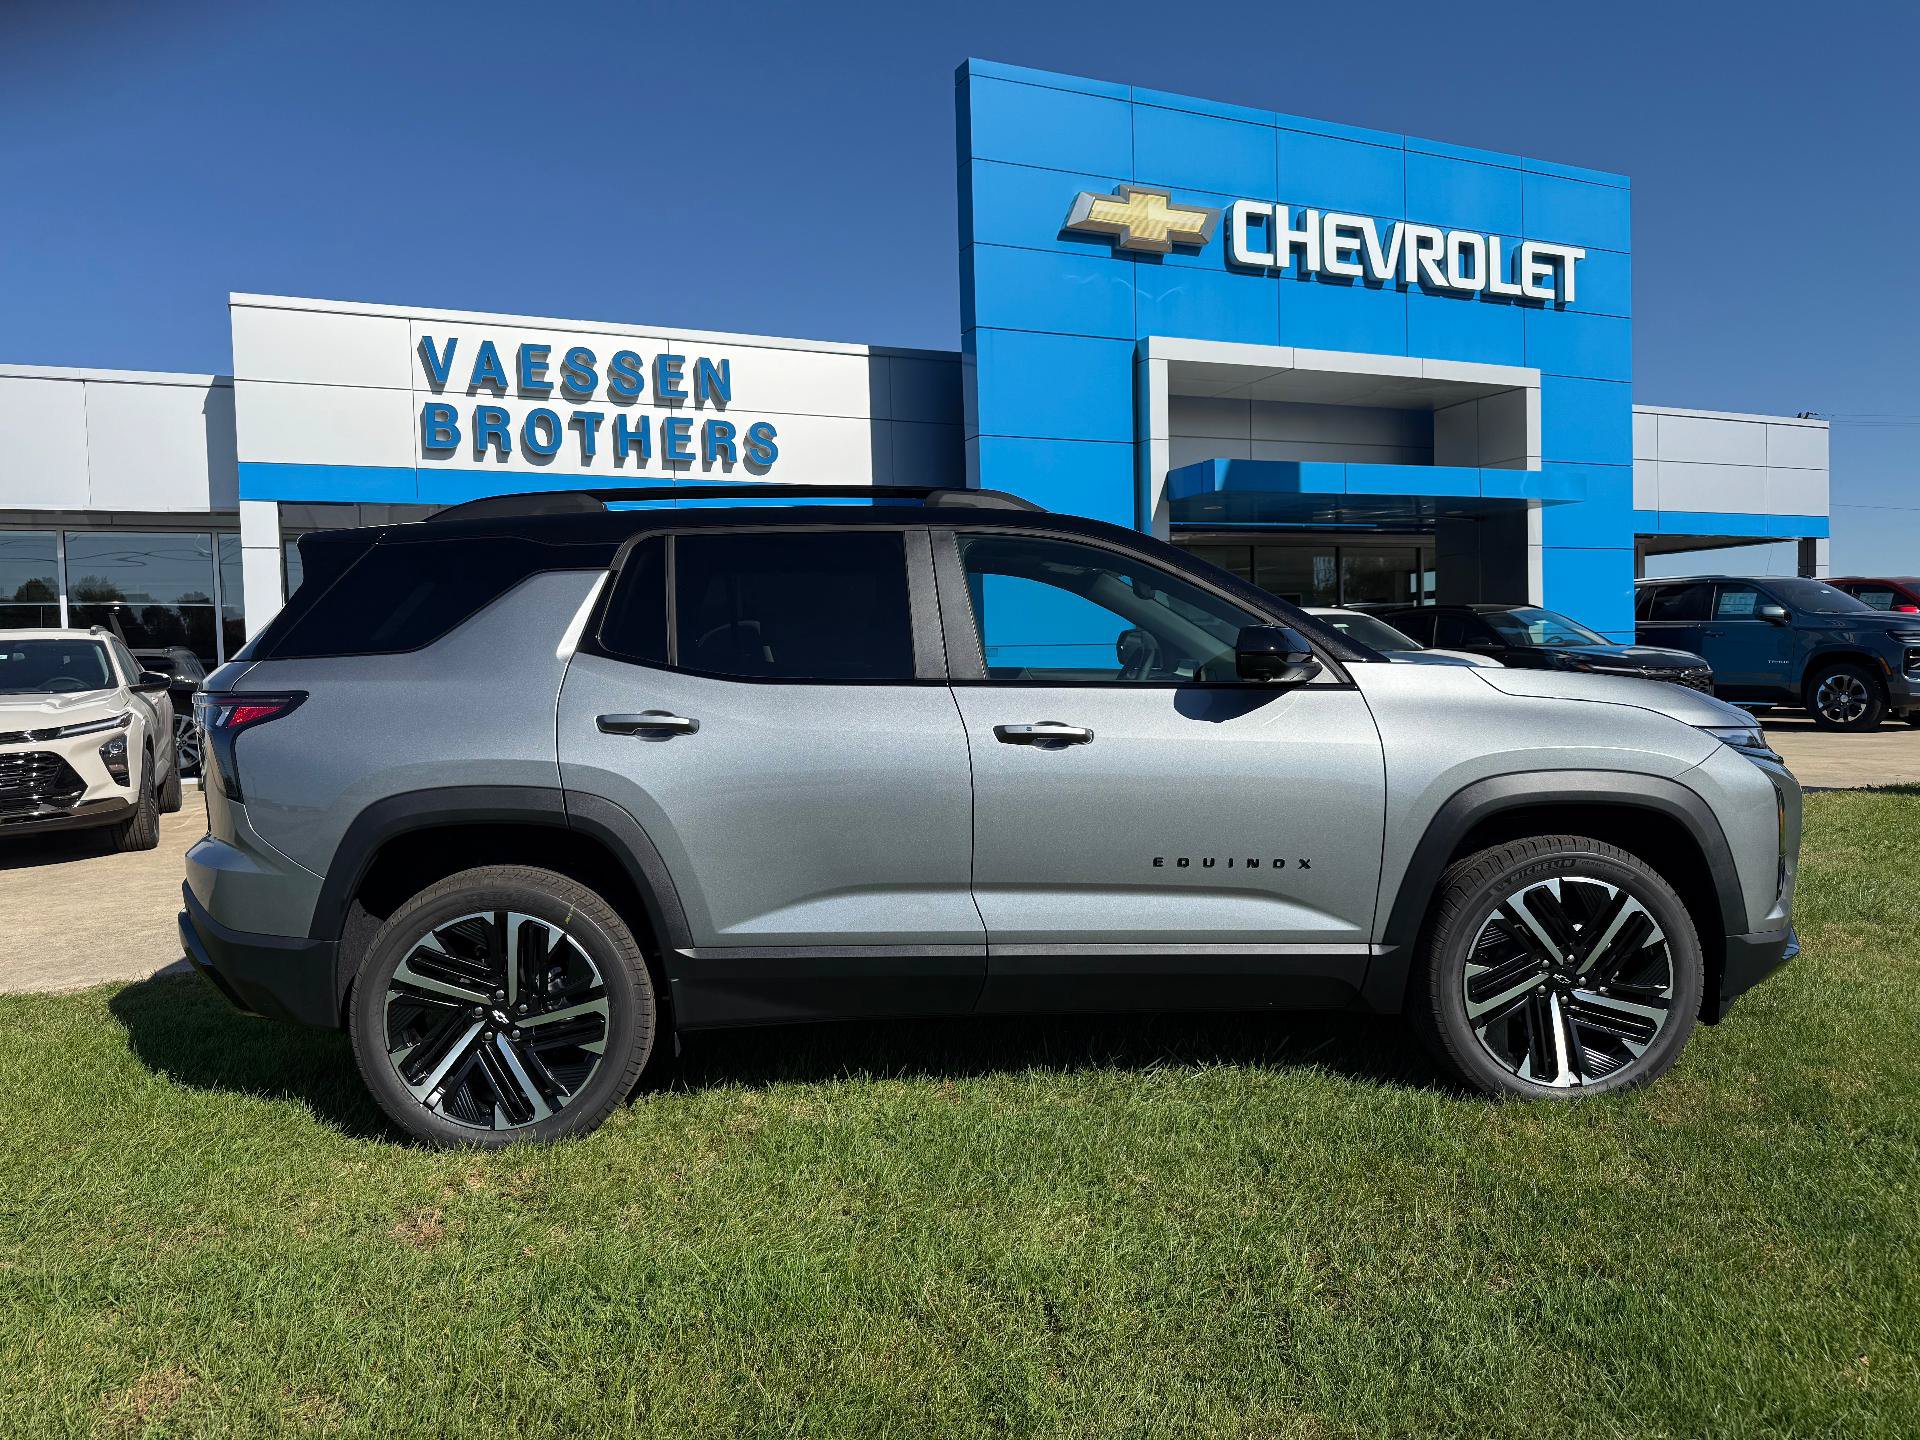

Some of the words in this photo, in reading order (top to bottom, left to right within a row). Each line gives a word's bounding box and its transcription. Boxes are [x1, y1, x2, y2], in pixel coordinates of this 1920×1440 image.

[1229, 200, 1586, 302] CHEVROLET
[418, 335, 732, 403] VAESSEN
[423, 401, 779, 467] BROTHERS
[1152, 856, 1312, 870] EQUINOX
[1510, 859, 1575, 882] MICHELIN
